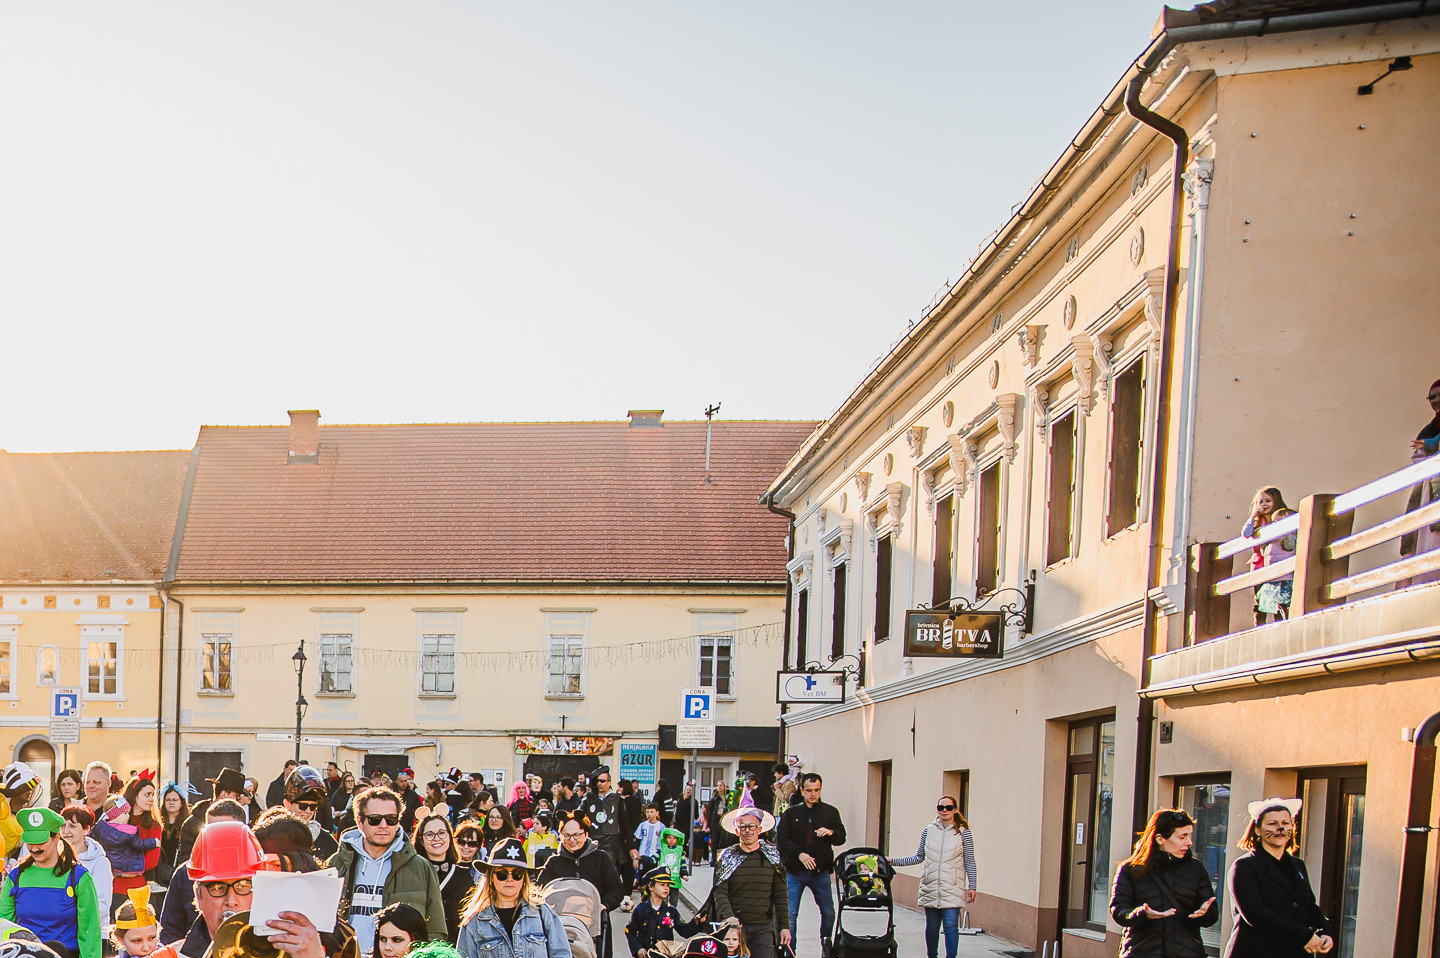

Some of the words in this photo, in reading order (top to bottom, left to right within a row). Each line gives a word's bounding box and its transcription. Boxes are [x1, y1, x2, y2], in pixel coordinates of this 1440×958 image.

[59, 696, 72, 714] P
[690, 697, 704, 716] P
[538, 740, 589, 751] FALAFEL
[622, 750, 653, 766] AŽUR
[32, 814, 39, 823] L
